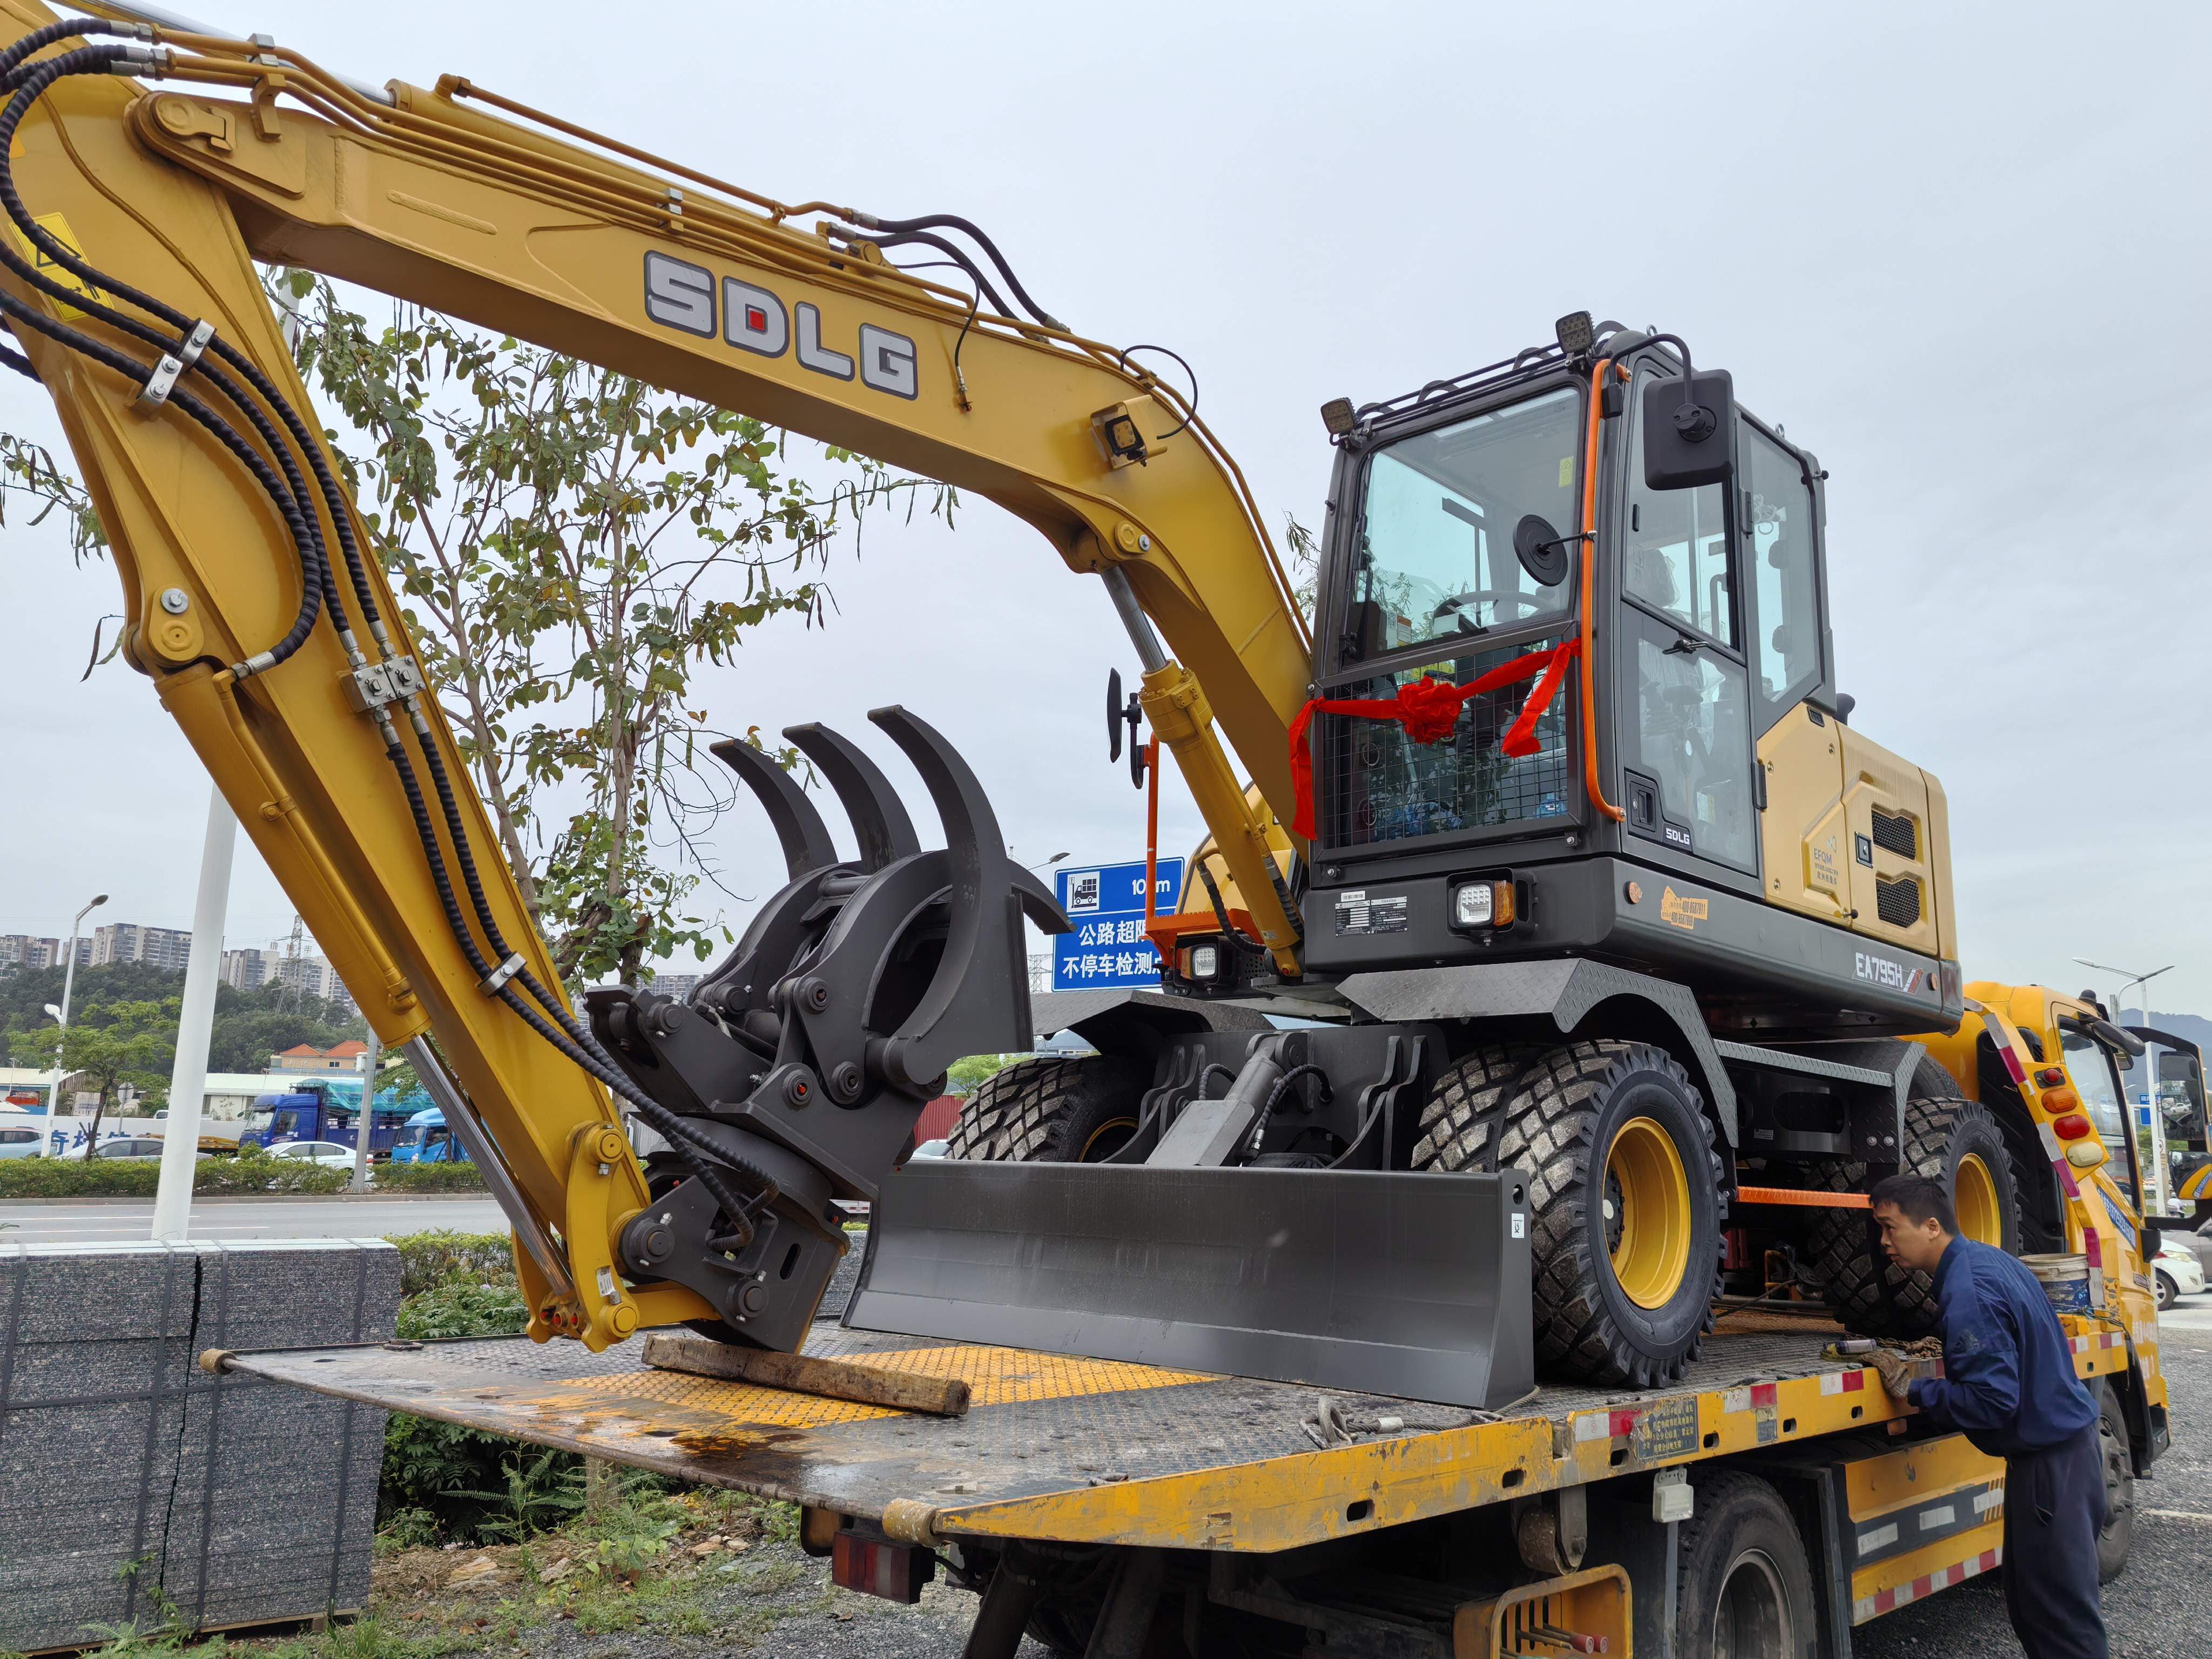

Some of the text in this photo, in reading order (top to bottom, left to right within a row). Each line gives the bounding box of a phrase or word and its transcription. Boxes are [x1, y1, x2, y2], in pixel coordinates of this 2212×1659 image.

[643, 249, 918, 401] SDLG
[1665, 827, 1690, 845] SDLG
[1813, 847, 1832, 866] EFQM
[1132, 878, 1170, 895] 10m
[1855, 952, 1903, 988] EA795H
